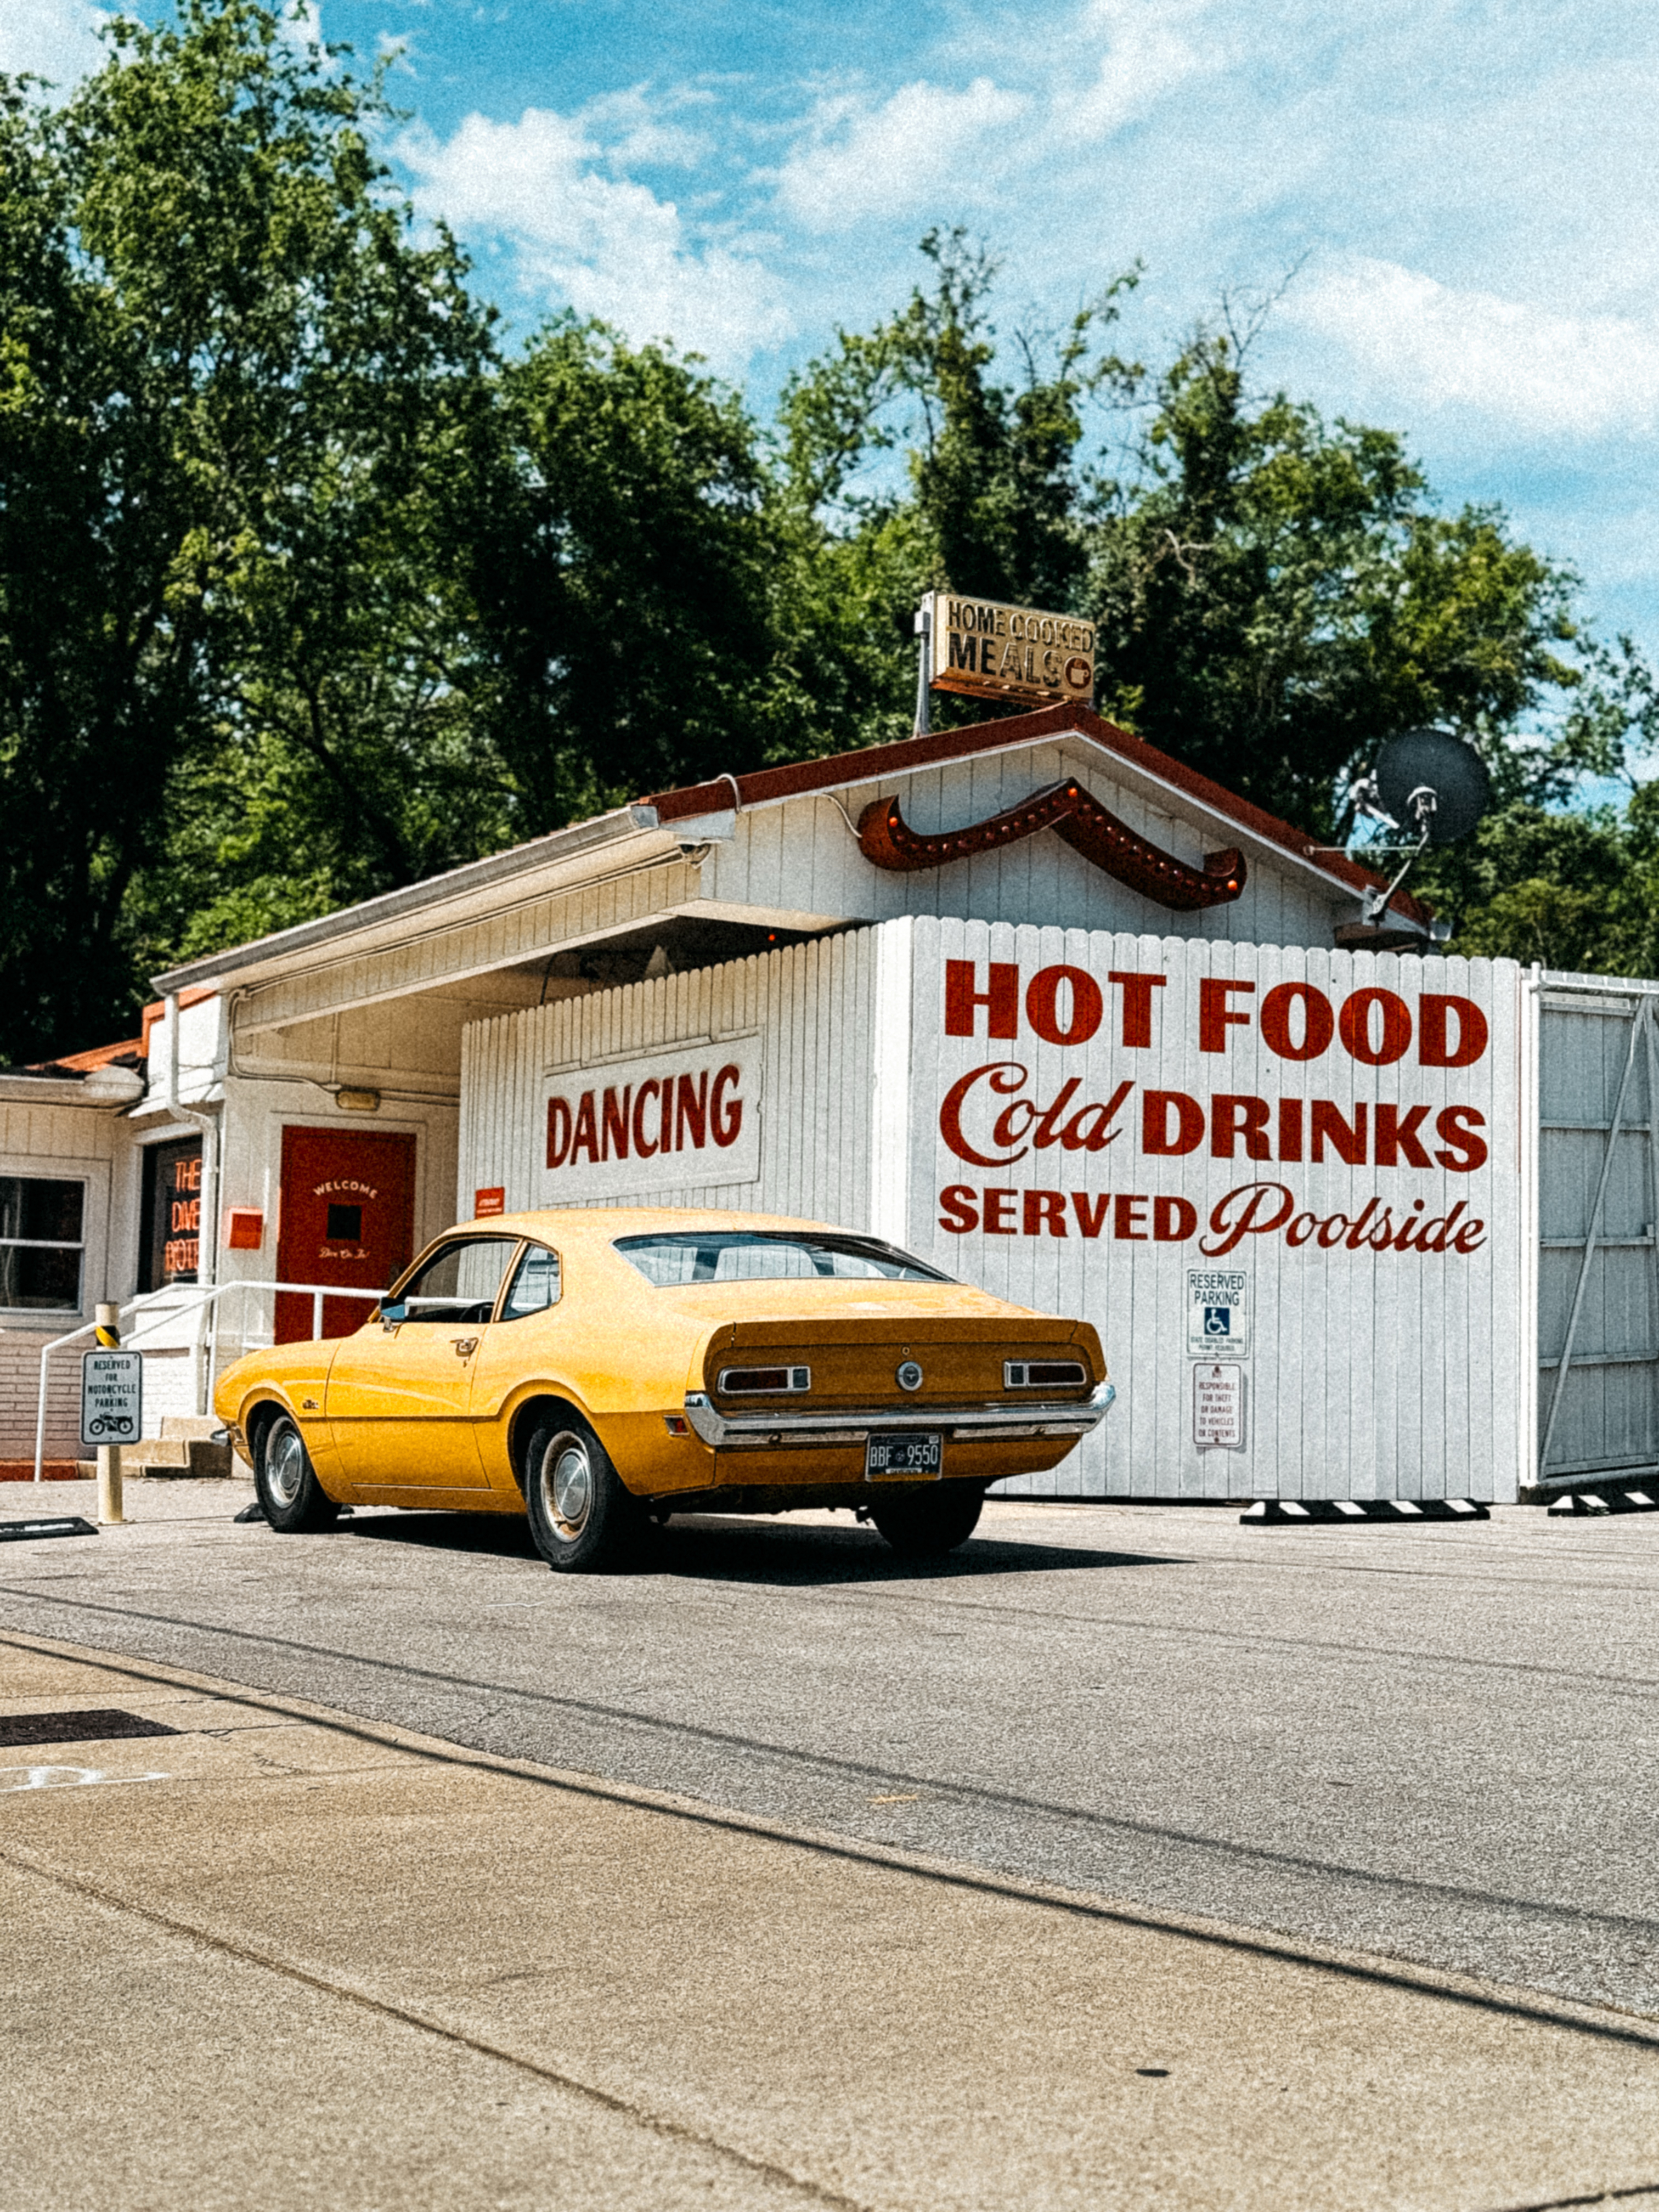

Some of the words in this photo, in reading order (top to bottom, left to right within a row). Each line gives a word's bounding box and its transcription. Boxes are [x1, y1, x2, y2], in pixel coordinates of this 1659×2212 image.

[949, 600, 1006, 636] HOME
[1009, 613, 1093, 653] COOKED
[949, 631, 1062, 687] MEALS
[945, 959, 1167, 1048] HOT
[1199, 978, 1488, 1068] FOOD
[546, 1064, 743, 1170] DANCING
[939, 1062, 1136, 1167] Cold
[1142, 1090, 1488, 1173] DRINKS
[175, 1159, 202, 1192] THE
[313, 1180, 377, 1199] WELCOME
[939, 1185, 1198, 1243] SERVED
[1199, 1182, 1487, 1257] Poolside
[1190, 1274, 1244, 1290] RESERVED
[1195, 1290, 1239, 1306] PARKING
[94, 1361, 130, 1370] RESERVED
[105, 1373, 117, 1381] FOR
[88, 1384, 136, 1394] MOTORCYCLE
[1199, 1382, 1235, 1390] RESPONSIBLE
[95, 1398, 128, 1408] PARKING
[1211, 1406, 1232, 1414] DAMAGE
[1208, 1429, 1235, 1437] CONTENTS
[870, 1446, 893, 1467] BBF
[907, 1445, 938, 1465] 9550
